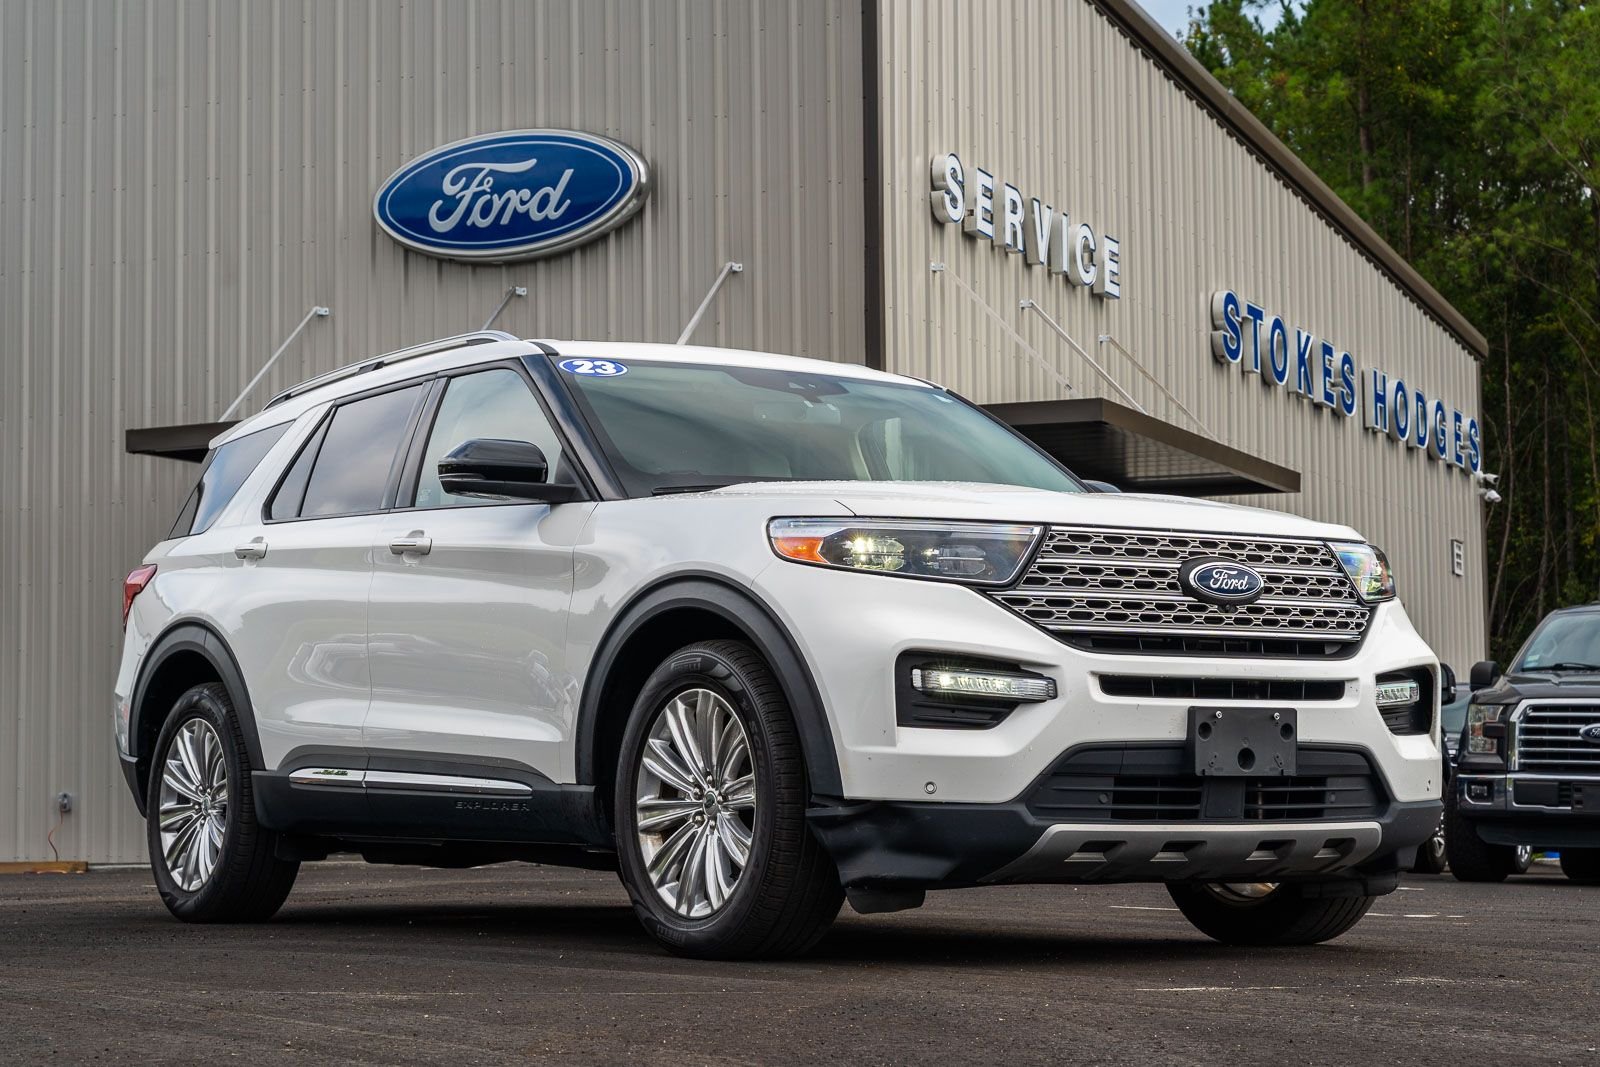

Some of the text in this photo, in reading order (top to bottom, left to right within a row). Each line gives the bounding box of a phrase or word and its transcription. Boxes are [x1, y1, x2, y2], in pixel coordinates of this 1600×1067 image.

[428, 158, 574, 233] Ford
[931, 153, 1120, 299] SERVICE
[572, 360, 617, 375] 23
[1211, 289, 1481, 474] STOKES HODGES
[1209, 568, 1249, 590] Ford
[455, 801, 531, 812] EXPLORER
